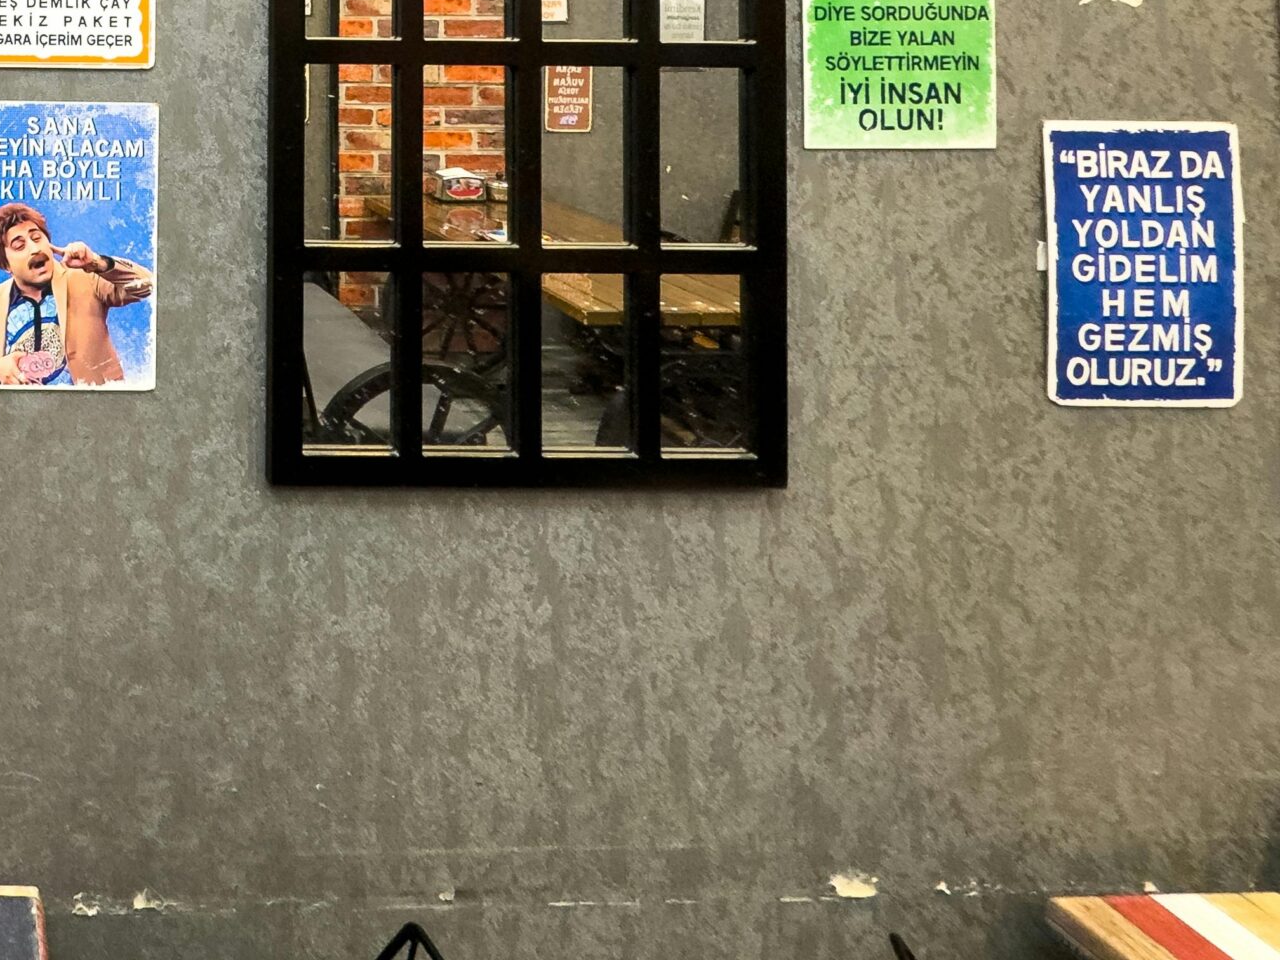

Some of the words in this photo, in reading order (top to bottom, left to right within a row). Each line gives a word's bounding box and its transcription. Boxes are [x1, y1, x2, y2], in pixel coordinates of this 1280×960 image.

[64, 16, 132, 28] PAKET
[814, 3, 855, 21] DİYE
[861, 3, 989, 21] SORDUĞUNDA
[35, 31, 82, 48] İÇERİM
[87, 35, 132, 48] GEÇER
[850, 28, 891, 47] BİZE
[897, 31, 955, 46] YALAN
[825, 52, 979, 71] SÖYLETTİRMEYİN
[840, 77, 869, 104] İYİ
[881, 77, 961, 104] İNSAN
[27, 117, 98, 136] SANA
[859, 108, 943, 131] OLUN!
[53, 139, 144, 158] ALACAM
[1, 160, 32, 178] HA
[43, 157, 121, 179] BÖYLE
[1180, 151, 1225, 179] DA
[0, 181, 121, 201] KIVRIMLI
[1079, 185, 1205, 220] YANLIŞ
[1072, 219, 1216, 248] YOLDAN
[1072, 247, 1218, 283] GİDELİM
[1102, 289, 1190, 318] HEM
[1077, 317, 1212, 359] GEZMİŞ
